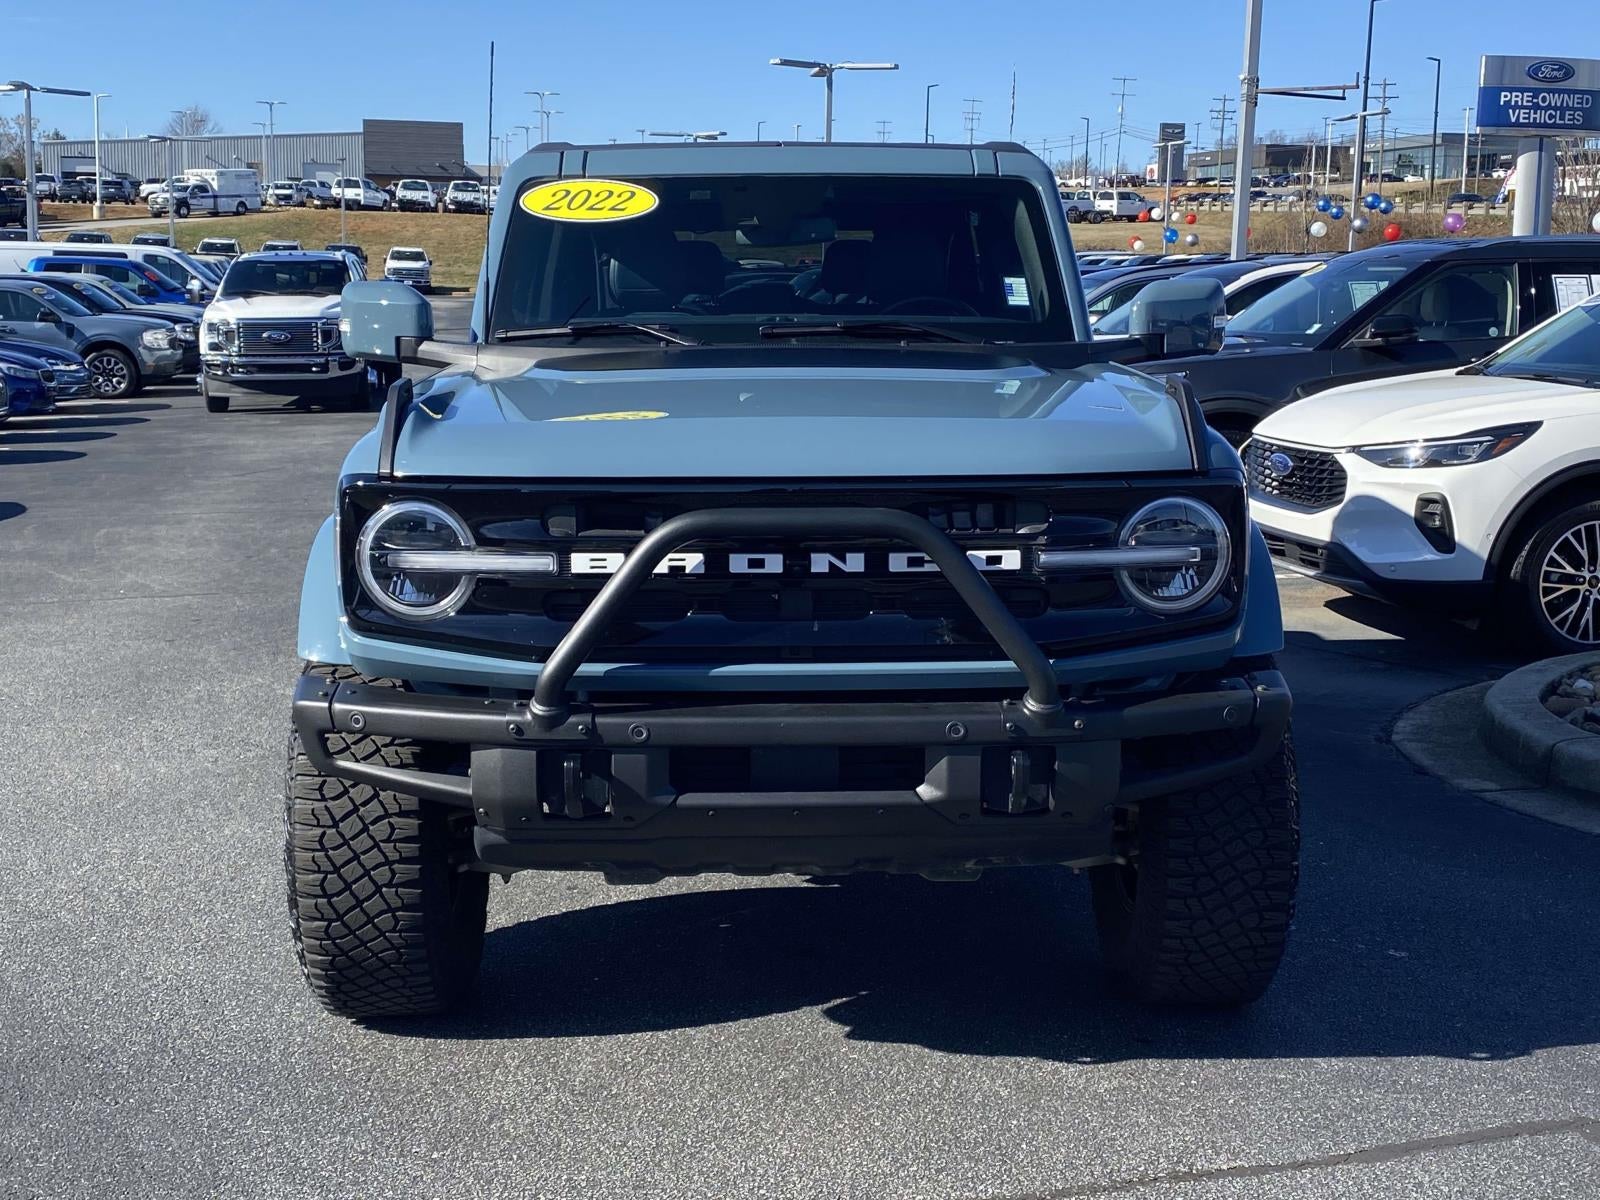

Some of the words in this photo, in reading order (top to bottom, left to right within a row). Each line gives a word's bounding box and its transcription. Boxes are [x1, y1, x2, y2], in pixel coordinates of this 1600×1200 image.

[1538, 64, 1565, 78] Ford
[1500, 91, 1592, 108] PRE-OWNED
[1508, 109, 1584, 124] VEHICLES
[541, 189, 636, 211] 2022
[570, 550, 1021, 573] BRONCO
